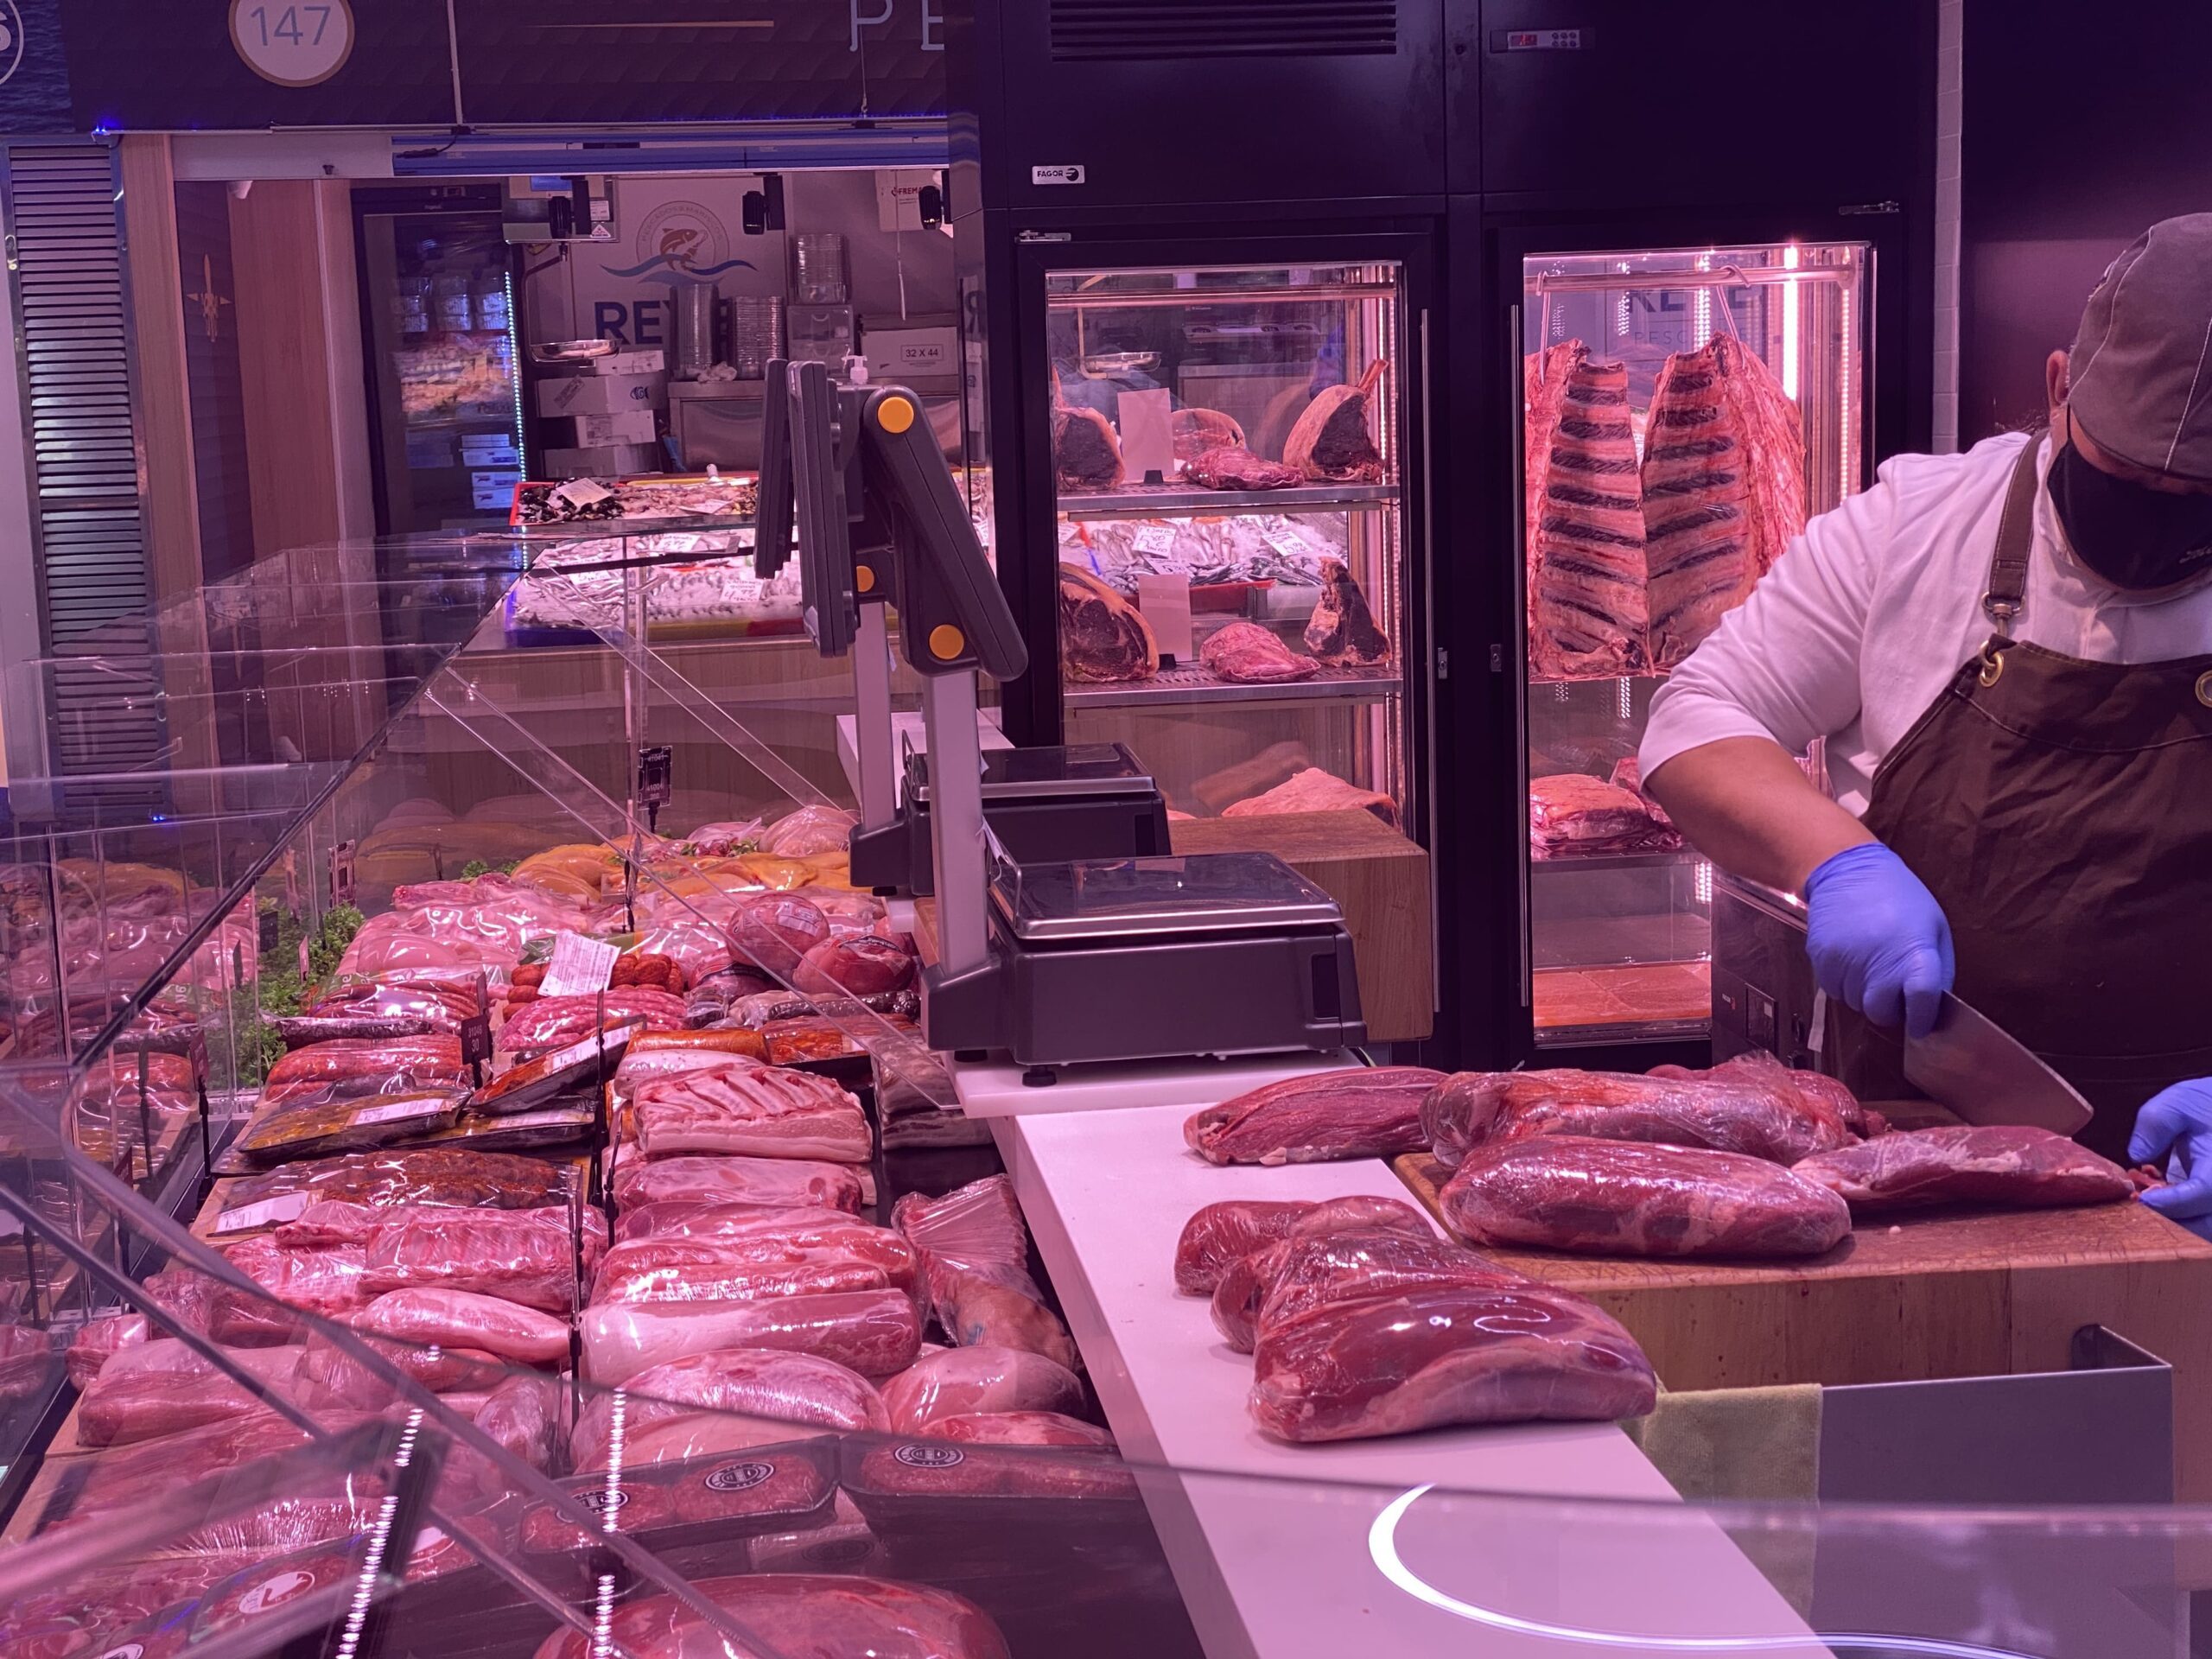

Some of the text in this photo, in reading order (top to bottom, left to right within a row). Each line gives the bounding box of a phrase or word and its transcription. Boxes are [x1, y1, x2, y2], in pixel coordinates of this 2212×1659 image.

[251, 6, 330, 46] 147
[899, 187, 924, 195] FREM
[906, 349, 917, 358] 32
